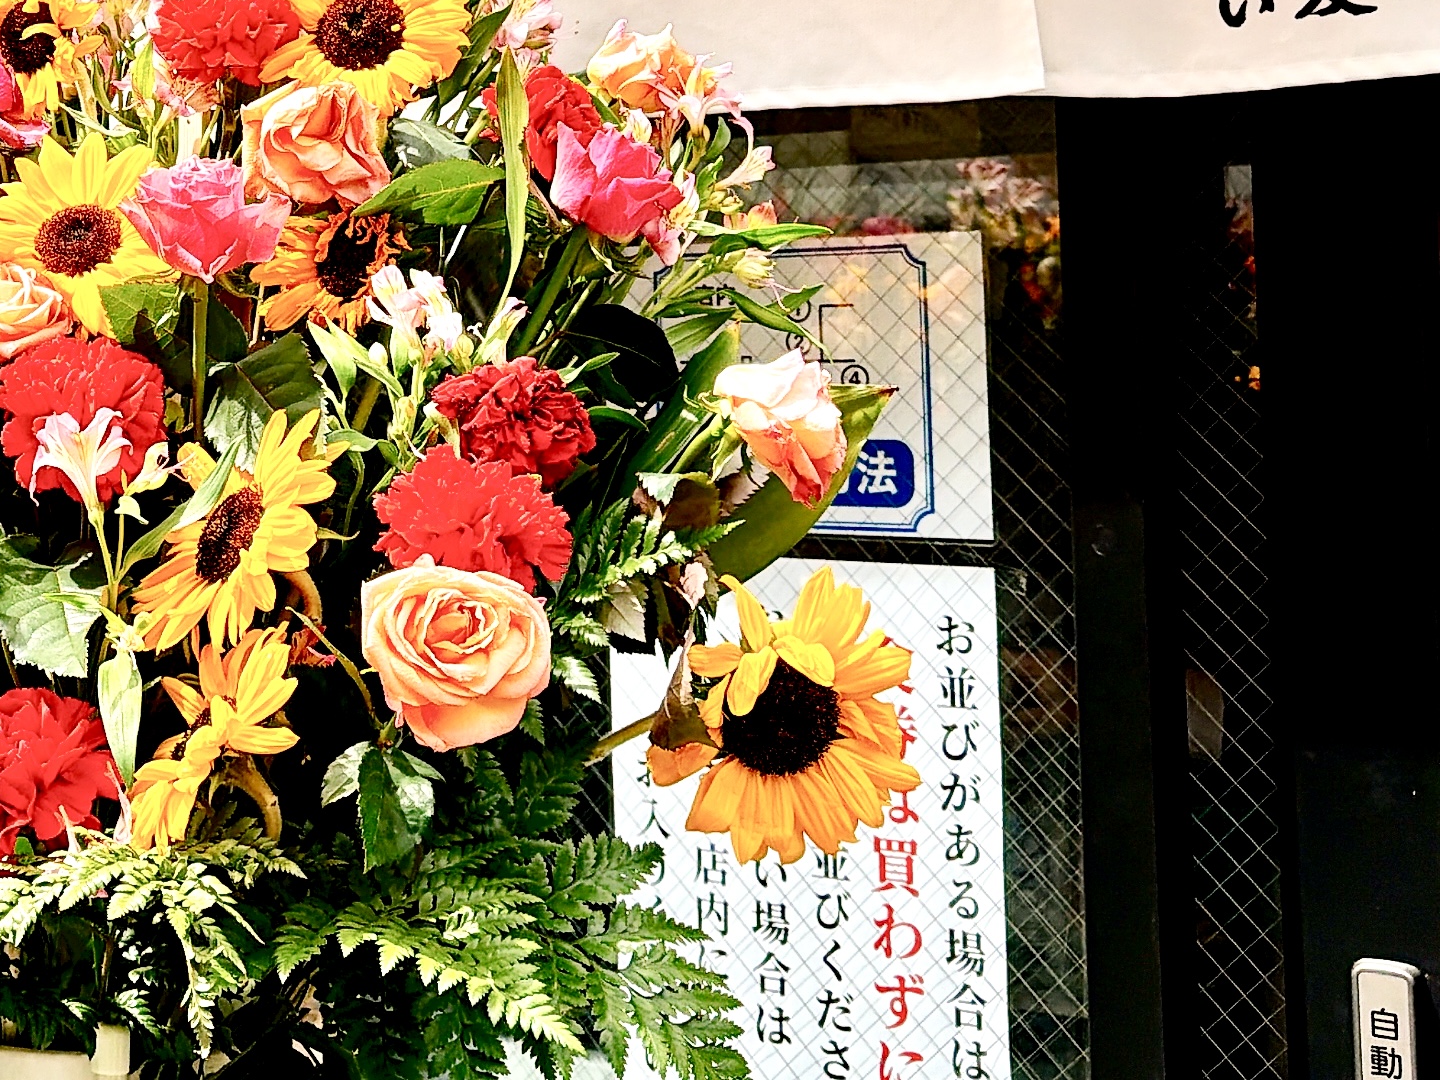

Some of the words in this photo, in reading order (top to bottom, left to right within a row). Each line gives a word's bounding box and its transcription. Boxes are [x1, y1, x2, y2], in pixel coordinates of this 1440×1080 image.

[937, 615, 990, 1079] お並びがある場合は
[1370, 1007, 1402, 1080] 自動
